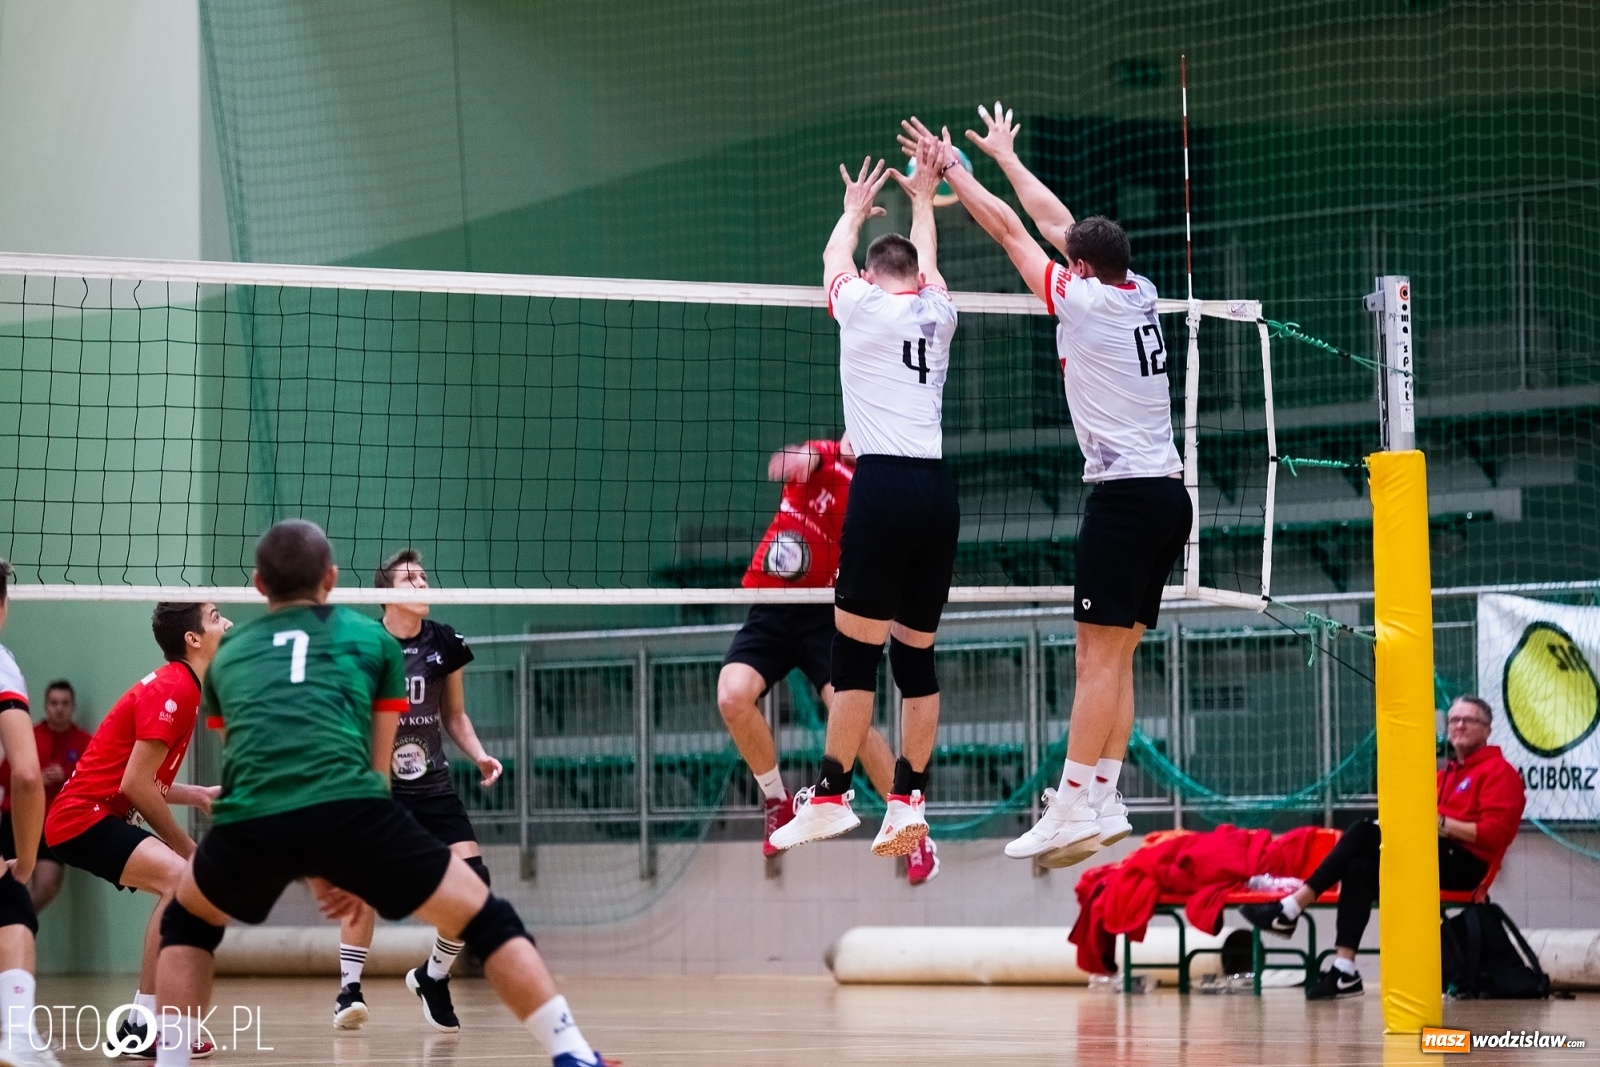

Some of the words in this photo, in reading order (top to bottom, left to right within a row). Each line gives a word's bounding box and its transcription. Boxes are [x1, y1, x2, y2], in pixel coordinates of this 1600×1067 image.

[902, 337, 930, 384] 4
[1133, 323, 1167, 377] 12
[272, 629, 310, 684] 7
[404, 675, 426, 705] 0
